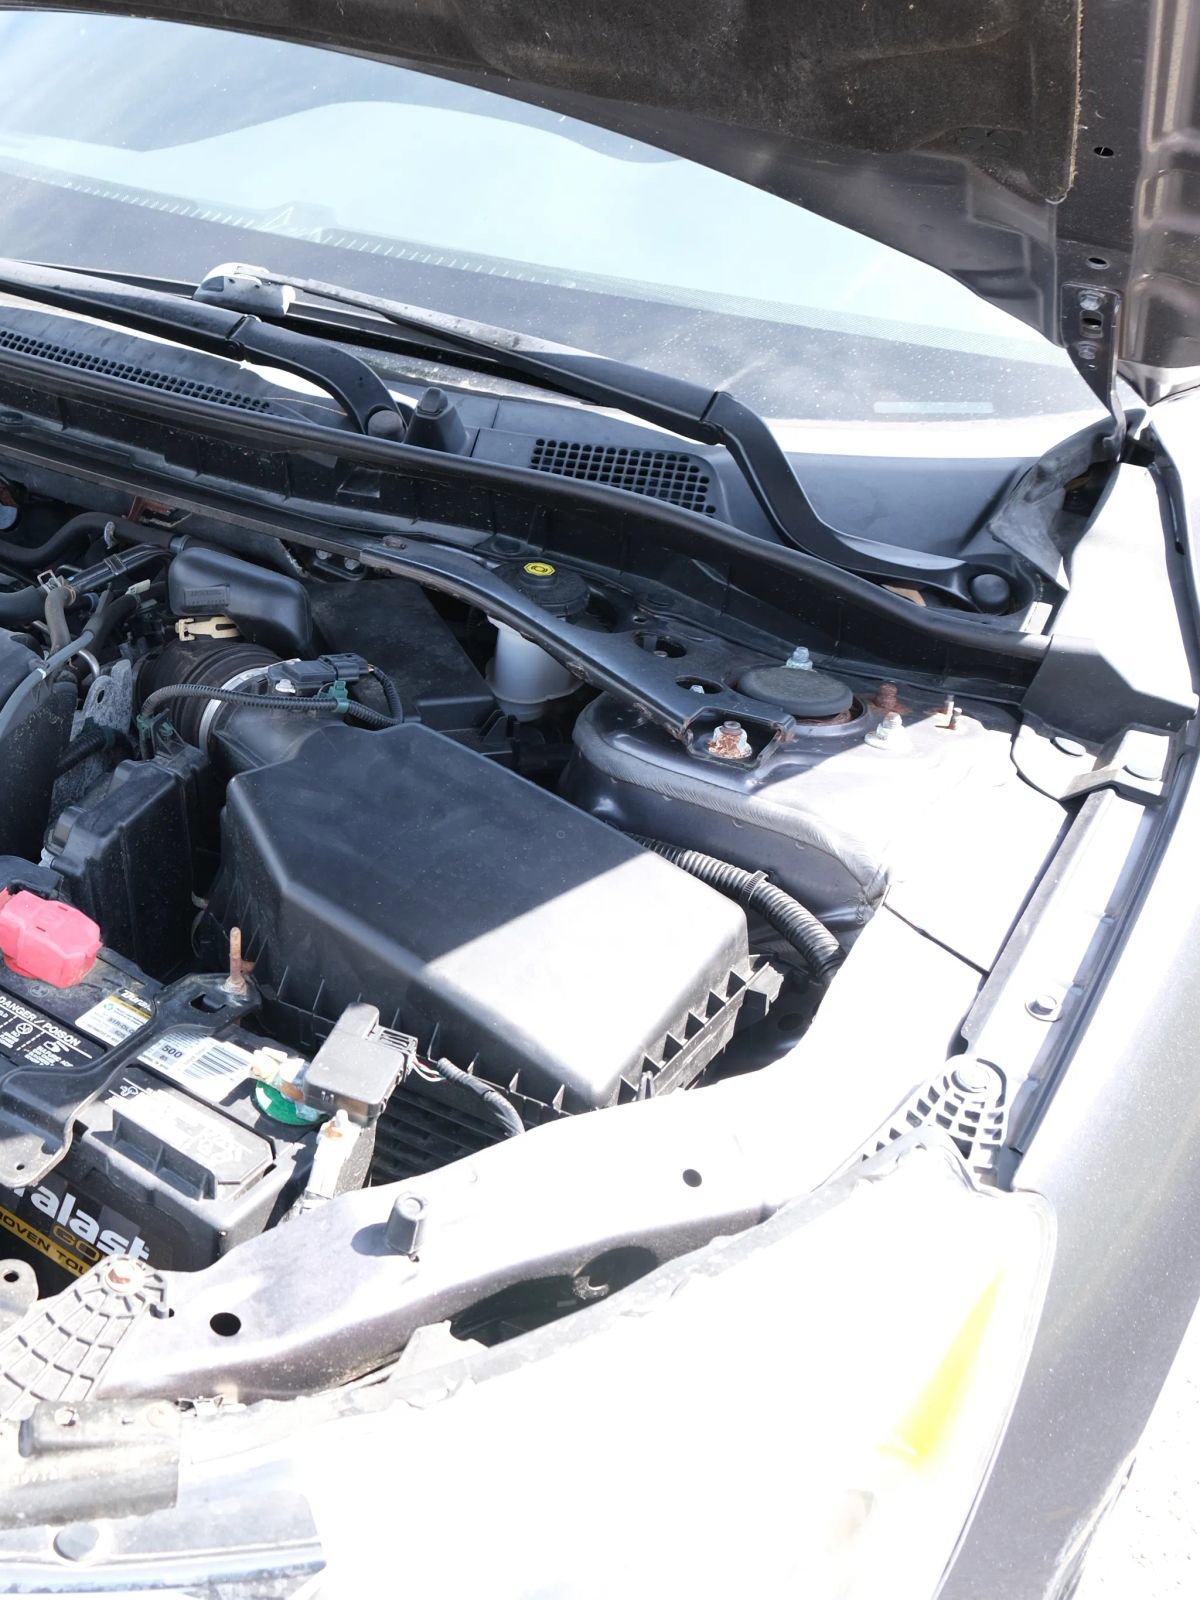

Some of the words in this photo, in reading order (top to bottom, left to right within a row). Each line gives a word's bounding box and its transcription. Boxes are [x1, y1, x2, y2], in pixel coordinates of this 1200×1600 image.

[121, 989, 152, 1011] Dural
[42, 1022, 81, 1047] POISON
[161, 1043, 183, 1058] 500
[13, 1183, 150, 1261] alast
[53, 1225, 103, 1262] GO
